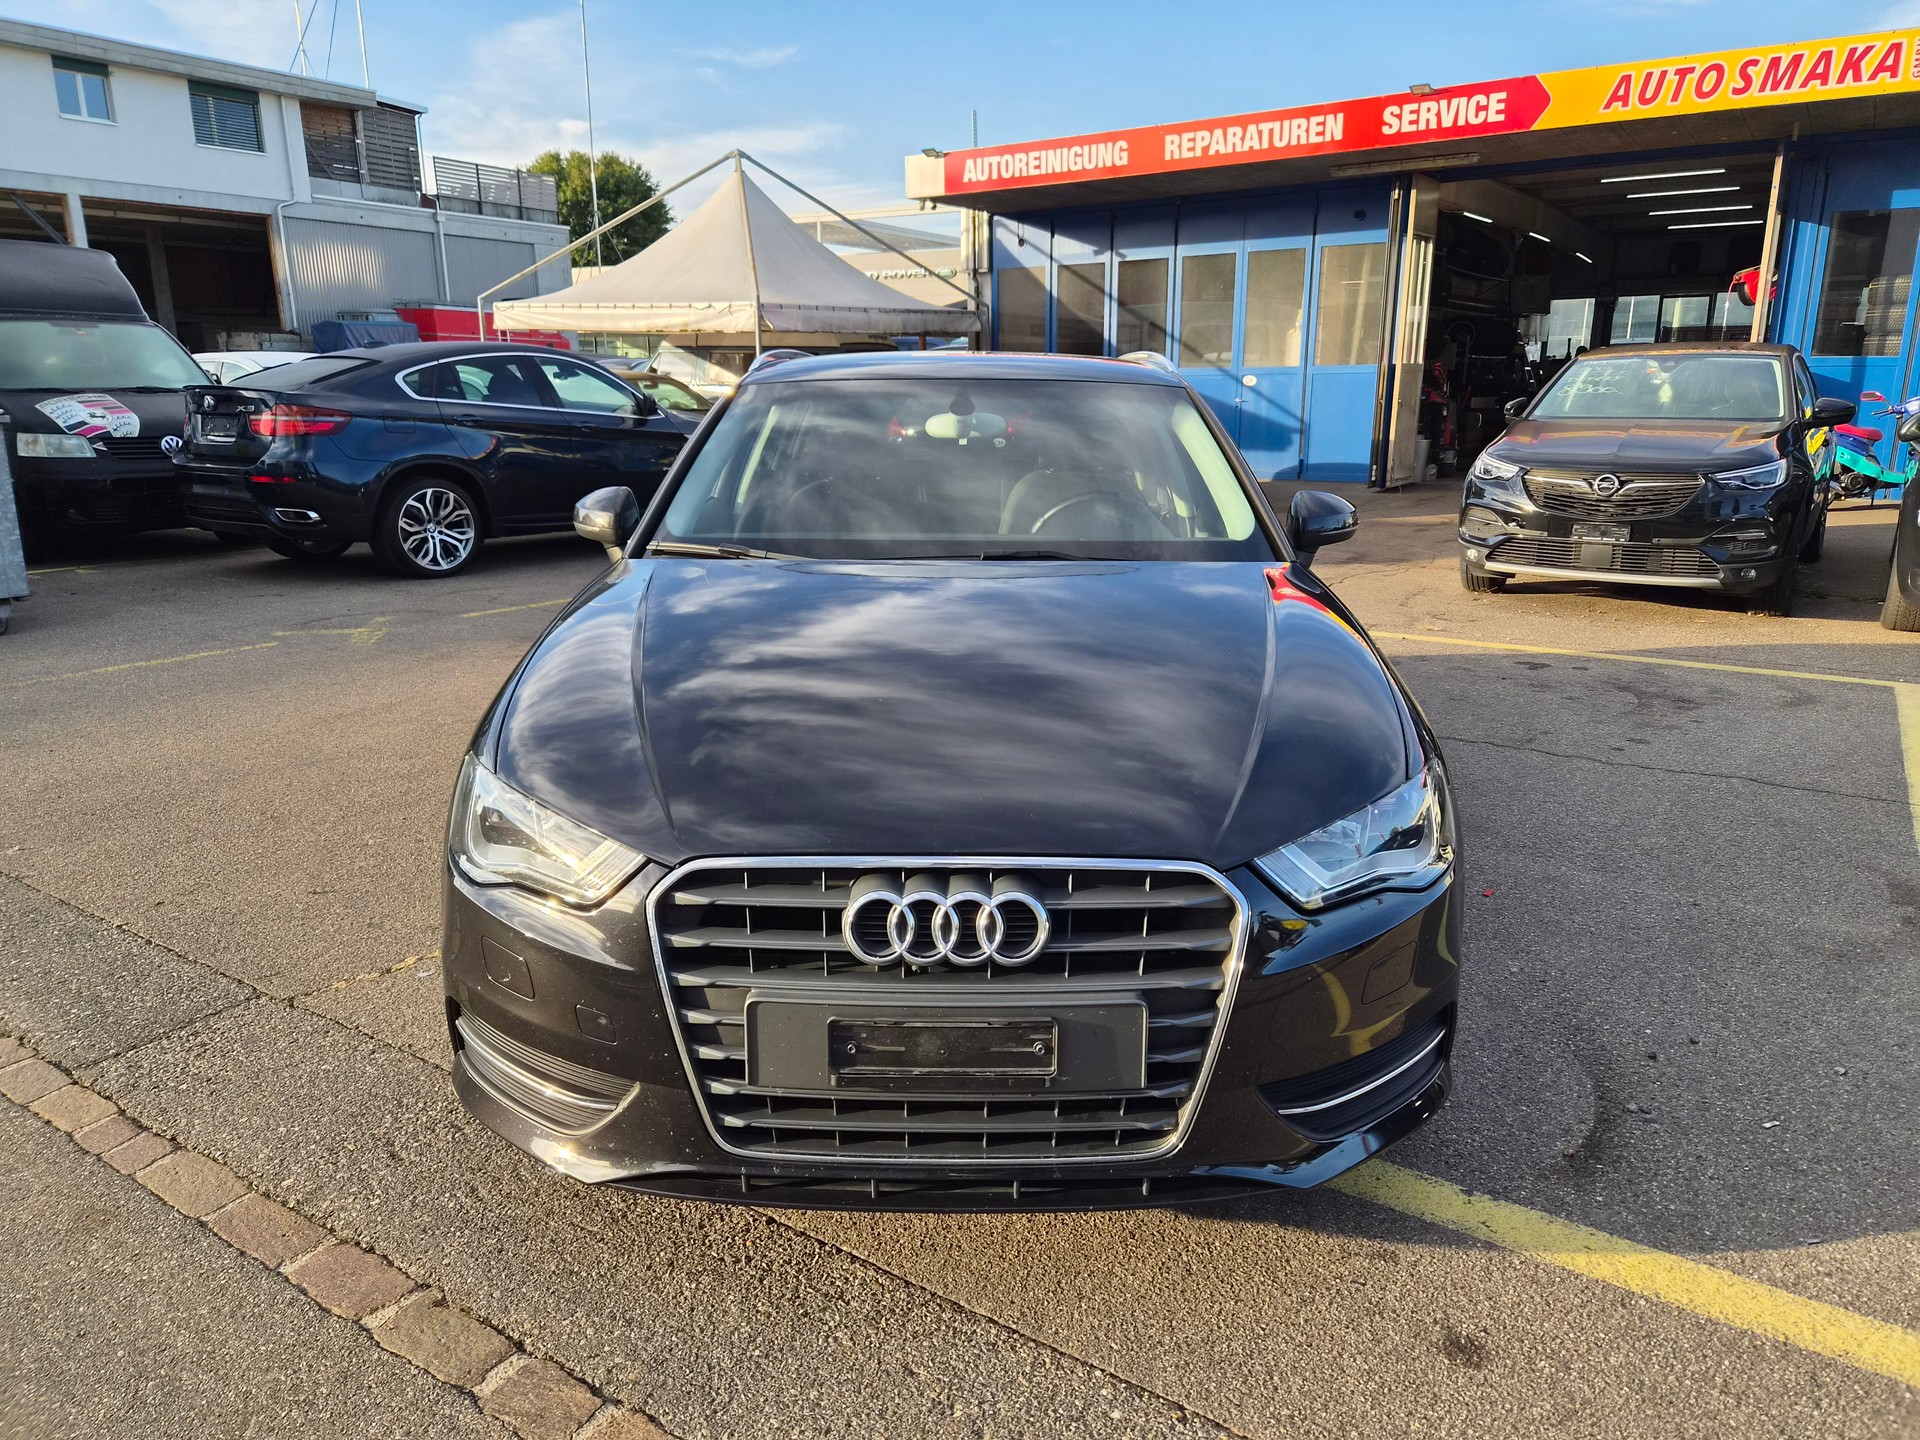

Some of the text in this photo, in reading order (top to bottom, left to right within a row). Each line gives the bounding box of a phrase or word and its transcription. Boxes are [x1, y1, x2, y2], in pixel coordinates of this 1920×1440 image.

[1602, 41, 1904, 111] AUTO SMAKA
[963, 91, 1508, 183] AUTOREINIGUNG REPARATUREN SERVICE
